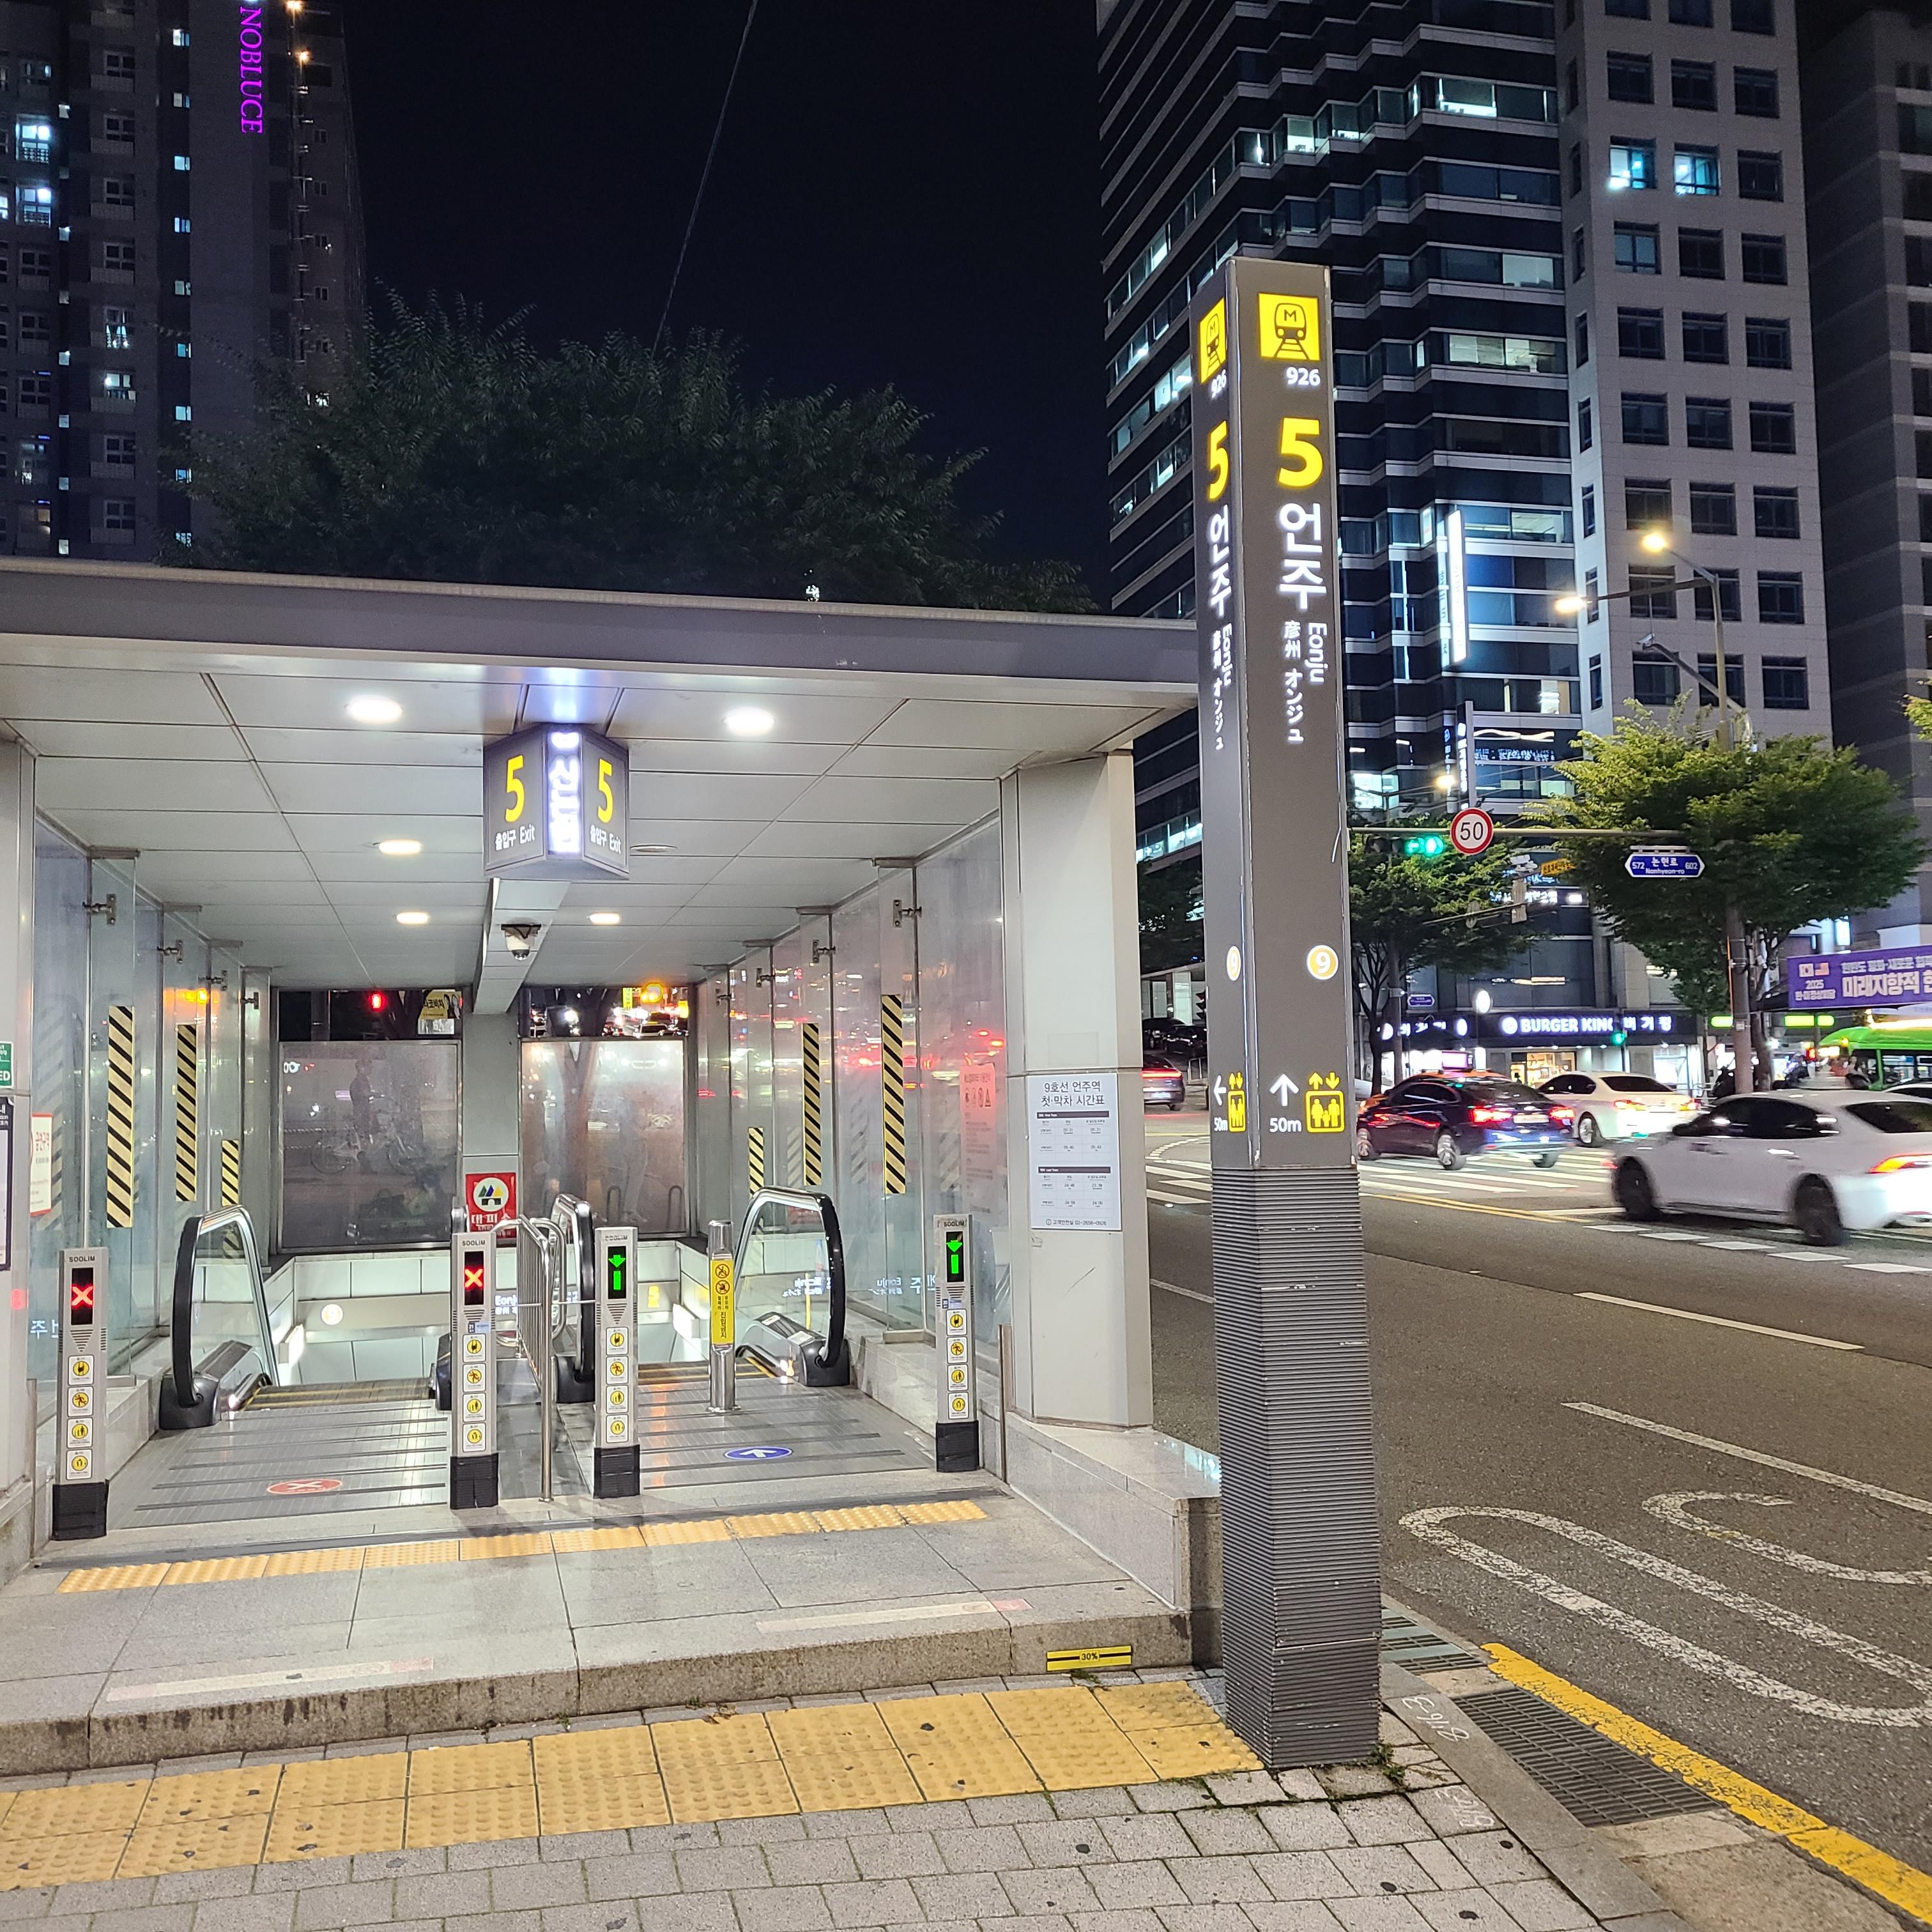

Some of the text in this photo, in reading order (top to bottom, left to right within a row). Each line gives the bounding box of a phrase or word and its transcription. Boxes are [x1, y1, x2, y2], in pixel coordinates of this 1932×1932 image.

[240, 6, 263, 134] NOBLUCE
[1211, 369, 1227, 397] 926
[1285, 367, 1321, 386] 926
[1208, 420, 1229, 500] 5
[1278, 417, 1324, 487] 5
[1209, 504, 1232, 617] 언주
[1279, 502, 1327, 610] 언주
[1284, 620, 1301, 659] 彦州
[1305, 622, 1328, 683] Eonju
[1222, 623, 1234, 687] Eonju
[1285, 668, 1304, 744] オンジュ
[505, 755, 525, 823] 5
[597, 758, 613, 824] 5
[494, 824, 535, 851] 출입구 Exit
[590, 824, 622, 854] 출입구 Exit
[1460, 822, 1483, 841] 50
[1632, 861, 1645, 870] 572
[1651, 857, 1679, 867] 논현로
[1315, 952, 1331, 974] 9
[1805, 979, 1825, 990] 2025
[1842, 970, 1920, 998] 미래지향적
[1519, 1017, 1579, 1032] BURGER
[1044, 1080, 1101, 1093] 9호선 언주역
[1041, 1094, 1105, 1107] 첫·막차 시간표
[1214, 1117, 1228, 1132] 50m
[1269, 1117, 1302, 1133] 50m
[68, 1255, 96, 1263] SOOLIM
[1081, 1652, 1098, 1661] 30%
